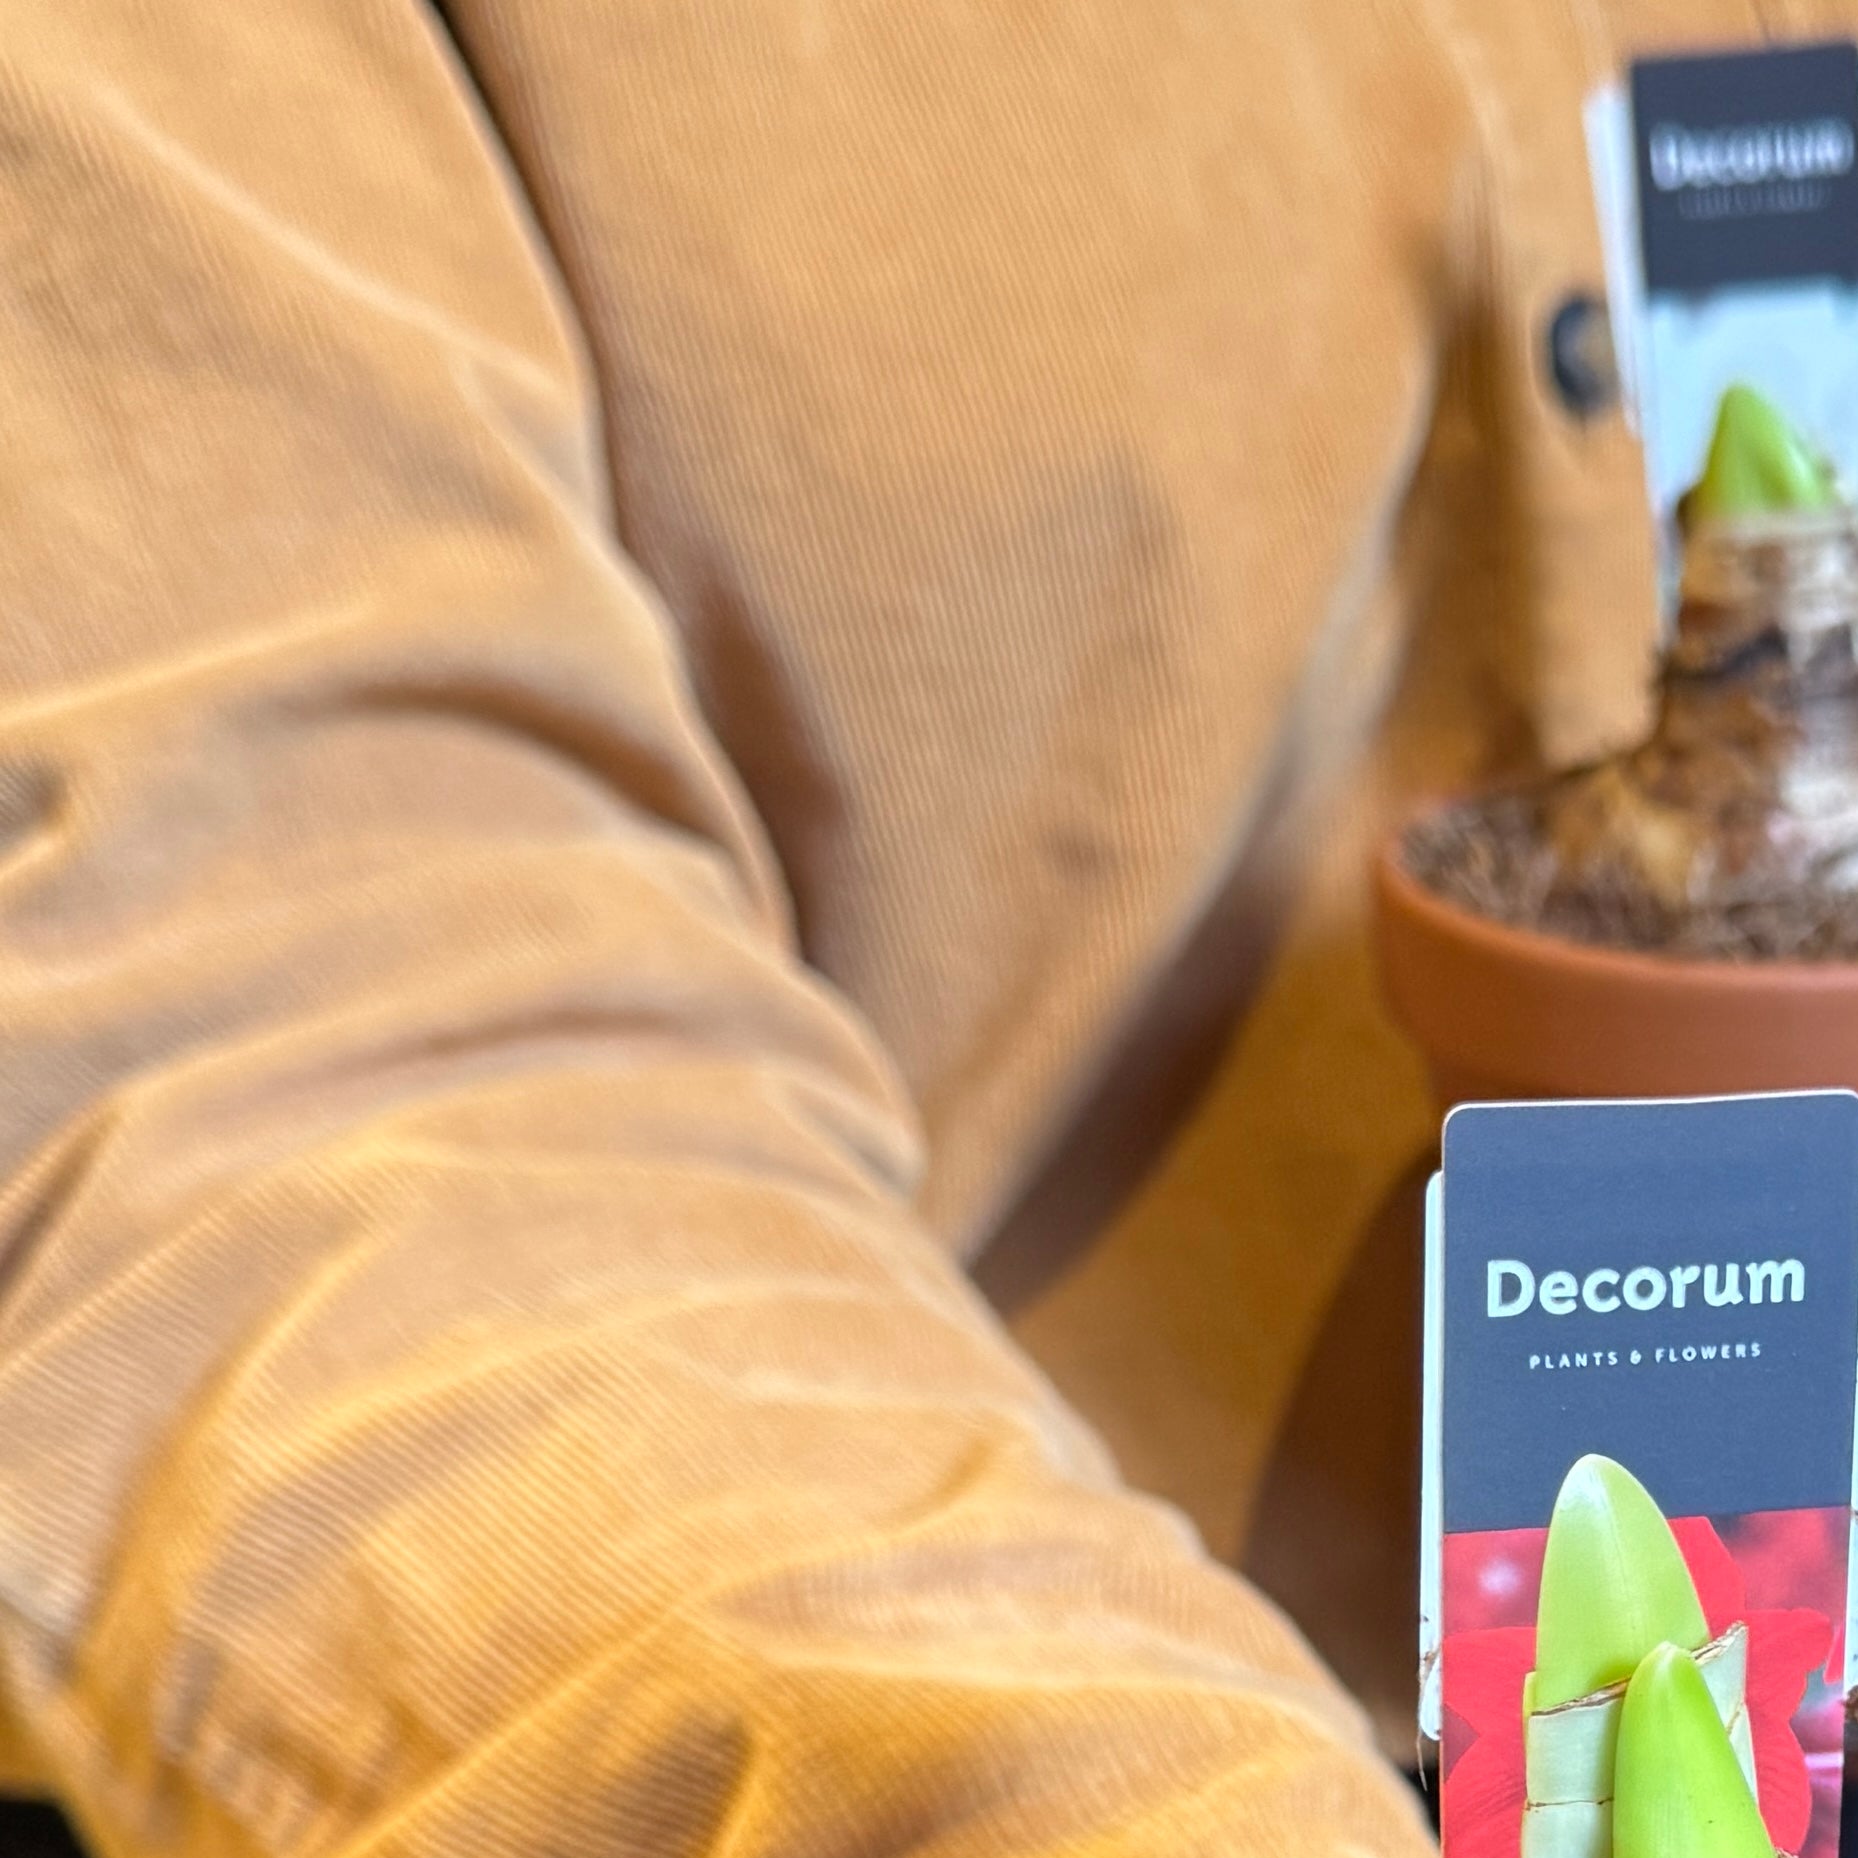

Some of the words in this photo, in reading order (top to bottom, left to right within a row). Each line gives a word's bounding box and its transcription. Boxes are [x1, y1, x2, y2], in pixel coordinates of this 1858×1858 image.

[1486, 1257, 1805, 1318] Decorum
[1529, 1351, 1618, 1369] PLANTS
[1654, 1342, 1761, 1364] FLOWERS
